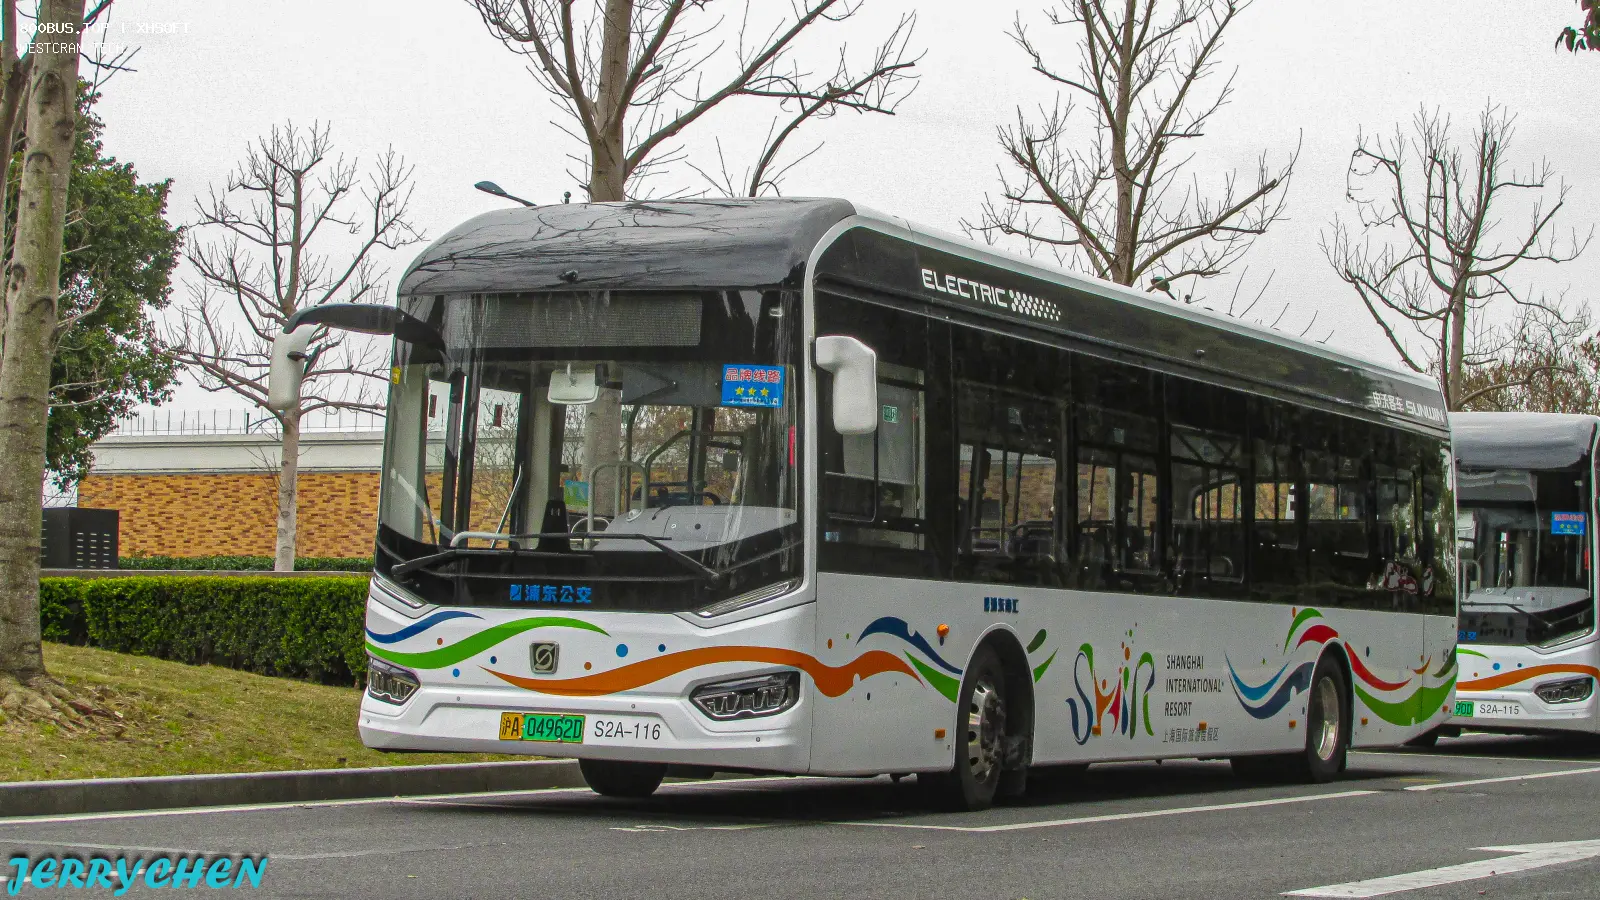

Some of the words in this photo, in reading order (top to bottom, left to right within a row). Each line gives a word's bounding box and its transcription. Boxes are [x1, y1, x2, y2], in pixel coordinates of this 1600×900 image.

[921, 268, 1008, 308] ELECTRIC
[725, 367, 781, 384] 品牌线路
[1405, 400, 1445, 423] SUNWIN
[525, 584, 592, 604] 浦东公交
[1166, 655, 1204, 670] SHANGHAI
[1165, 678, 1222, 693] INTERNATIONAL
[1164, 701, 1193, 717] RESORT
[1479, 704, 1520, 715] S2A-115
[594, 720, 661, 740] S2A-116
